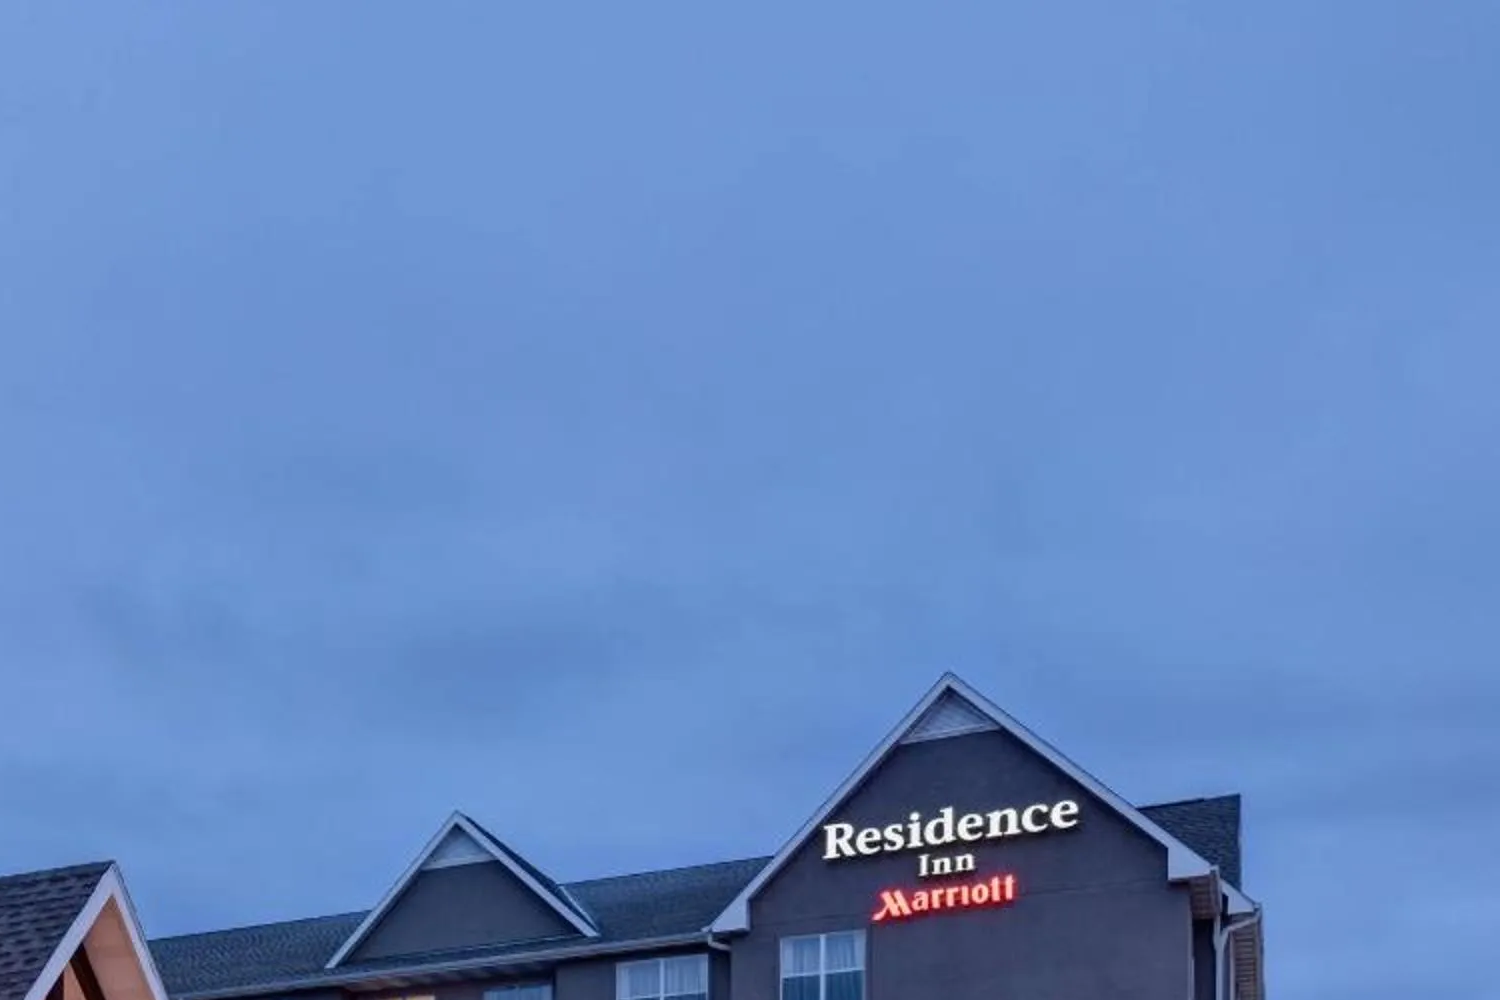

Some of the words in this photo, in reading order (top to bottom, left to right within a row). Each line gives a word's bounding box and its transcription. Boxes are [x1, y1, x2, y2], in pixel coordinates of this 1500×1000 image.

[822, 799, 1079, 860] Residence
[918, 852, 976, 878] Inn
[871, 874, 1017, 922] Marriott
